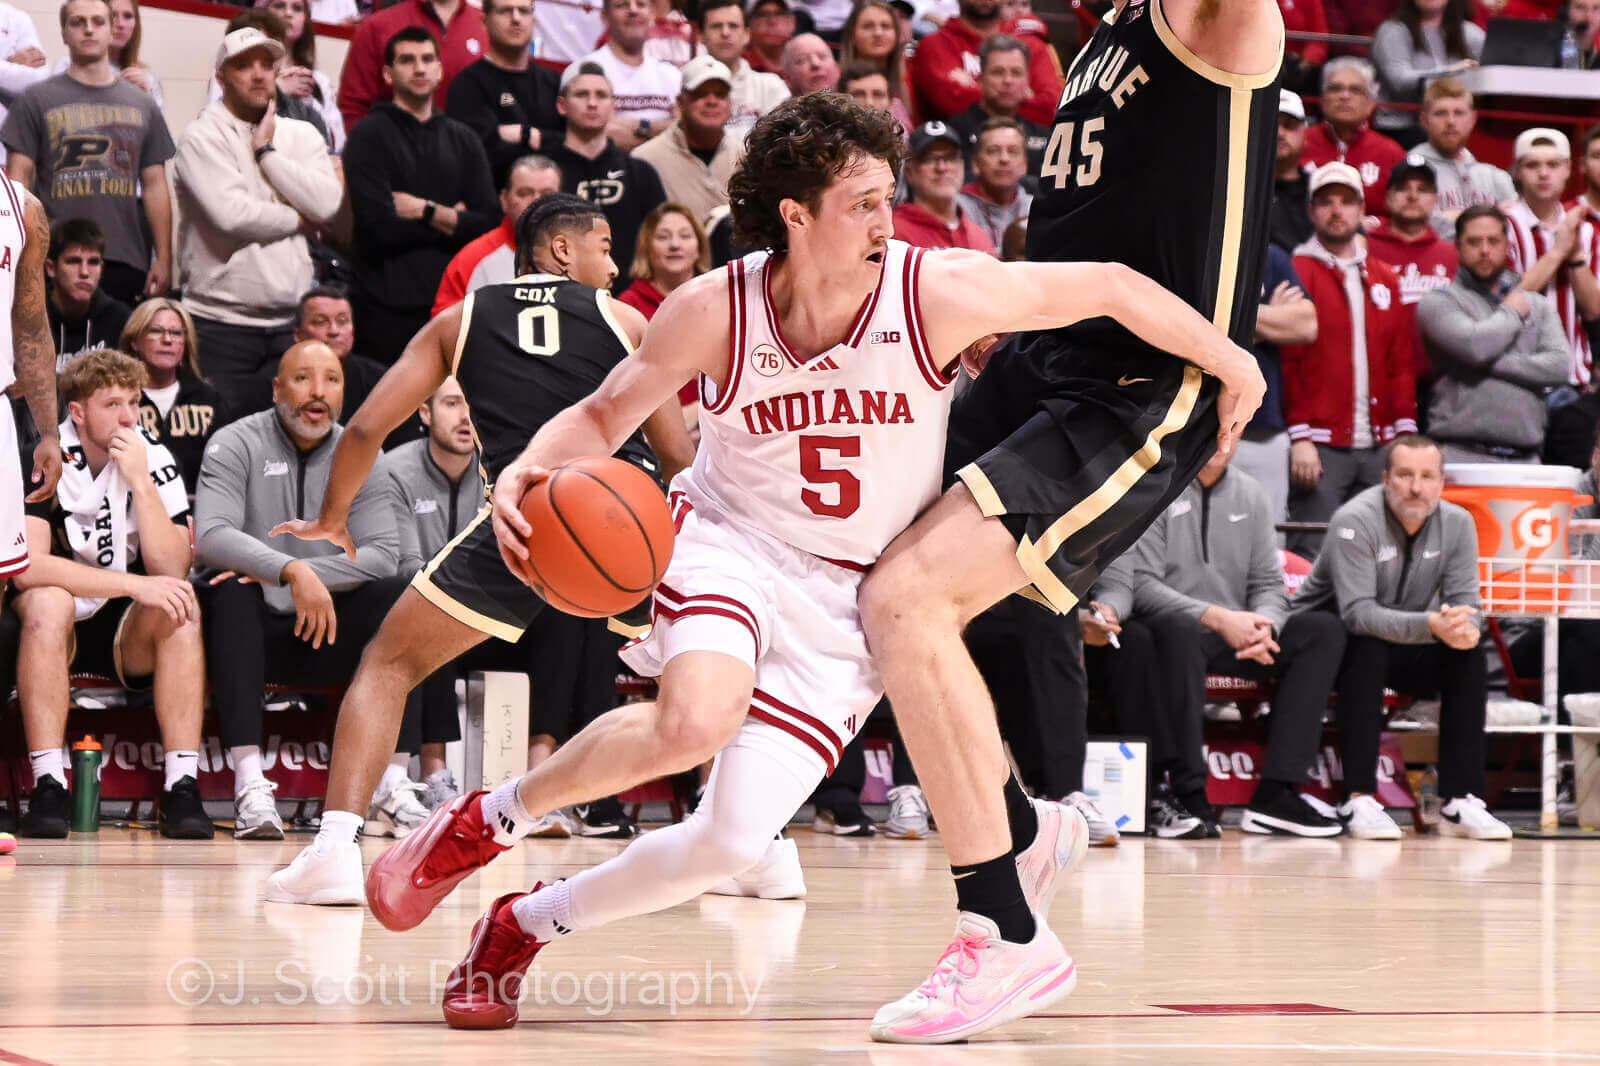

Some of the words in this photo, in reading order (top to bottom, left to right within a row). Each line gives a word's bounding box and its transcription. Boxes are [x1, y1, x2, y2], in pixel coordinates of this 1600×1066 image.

[1040, 116, 1105, 190] 45
[514, 286, 558, 304] COX
[517, 304, 560, 357] 0
[741, 388, 915, 435] INDIANA
[799, 435, 861, 519] 5
[1519, 508, 1552, 548] G
